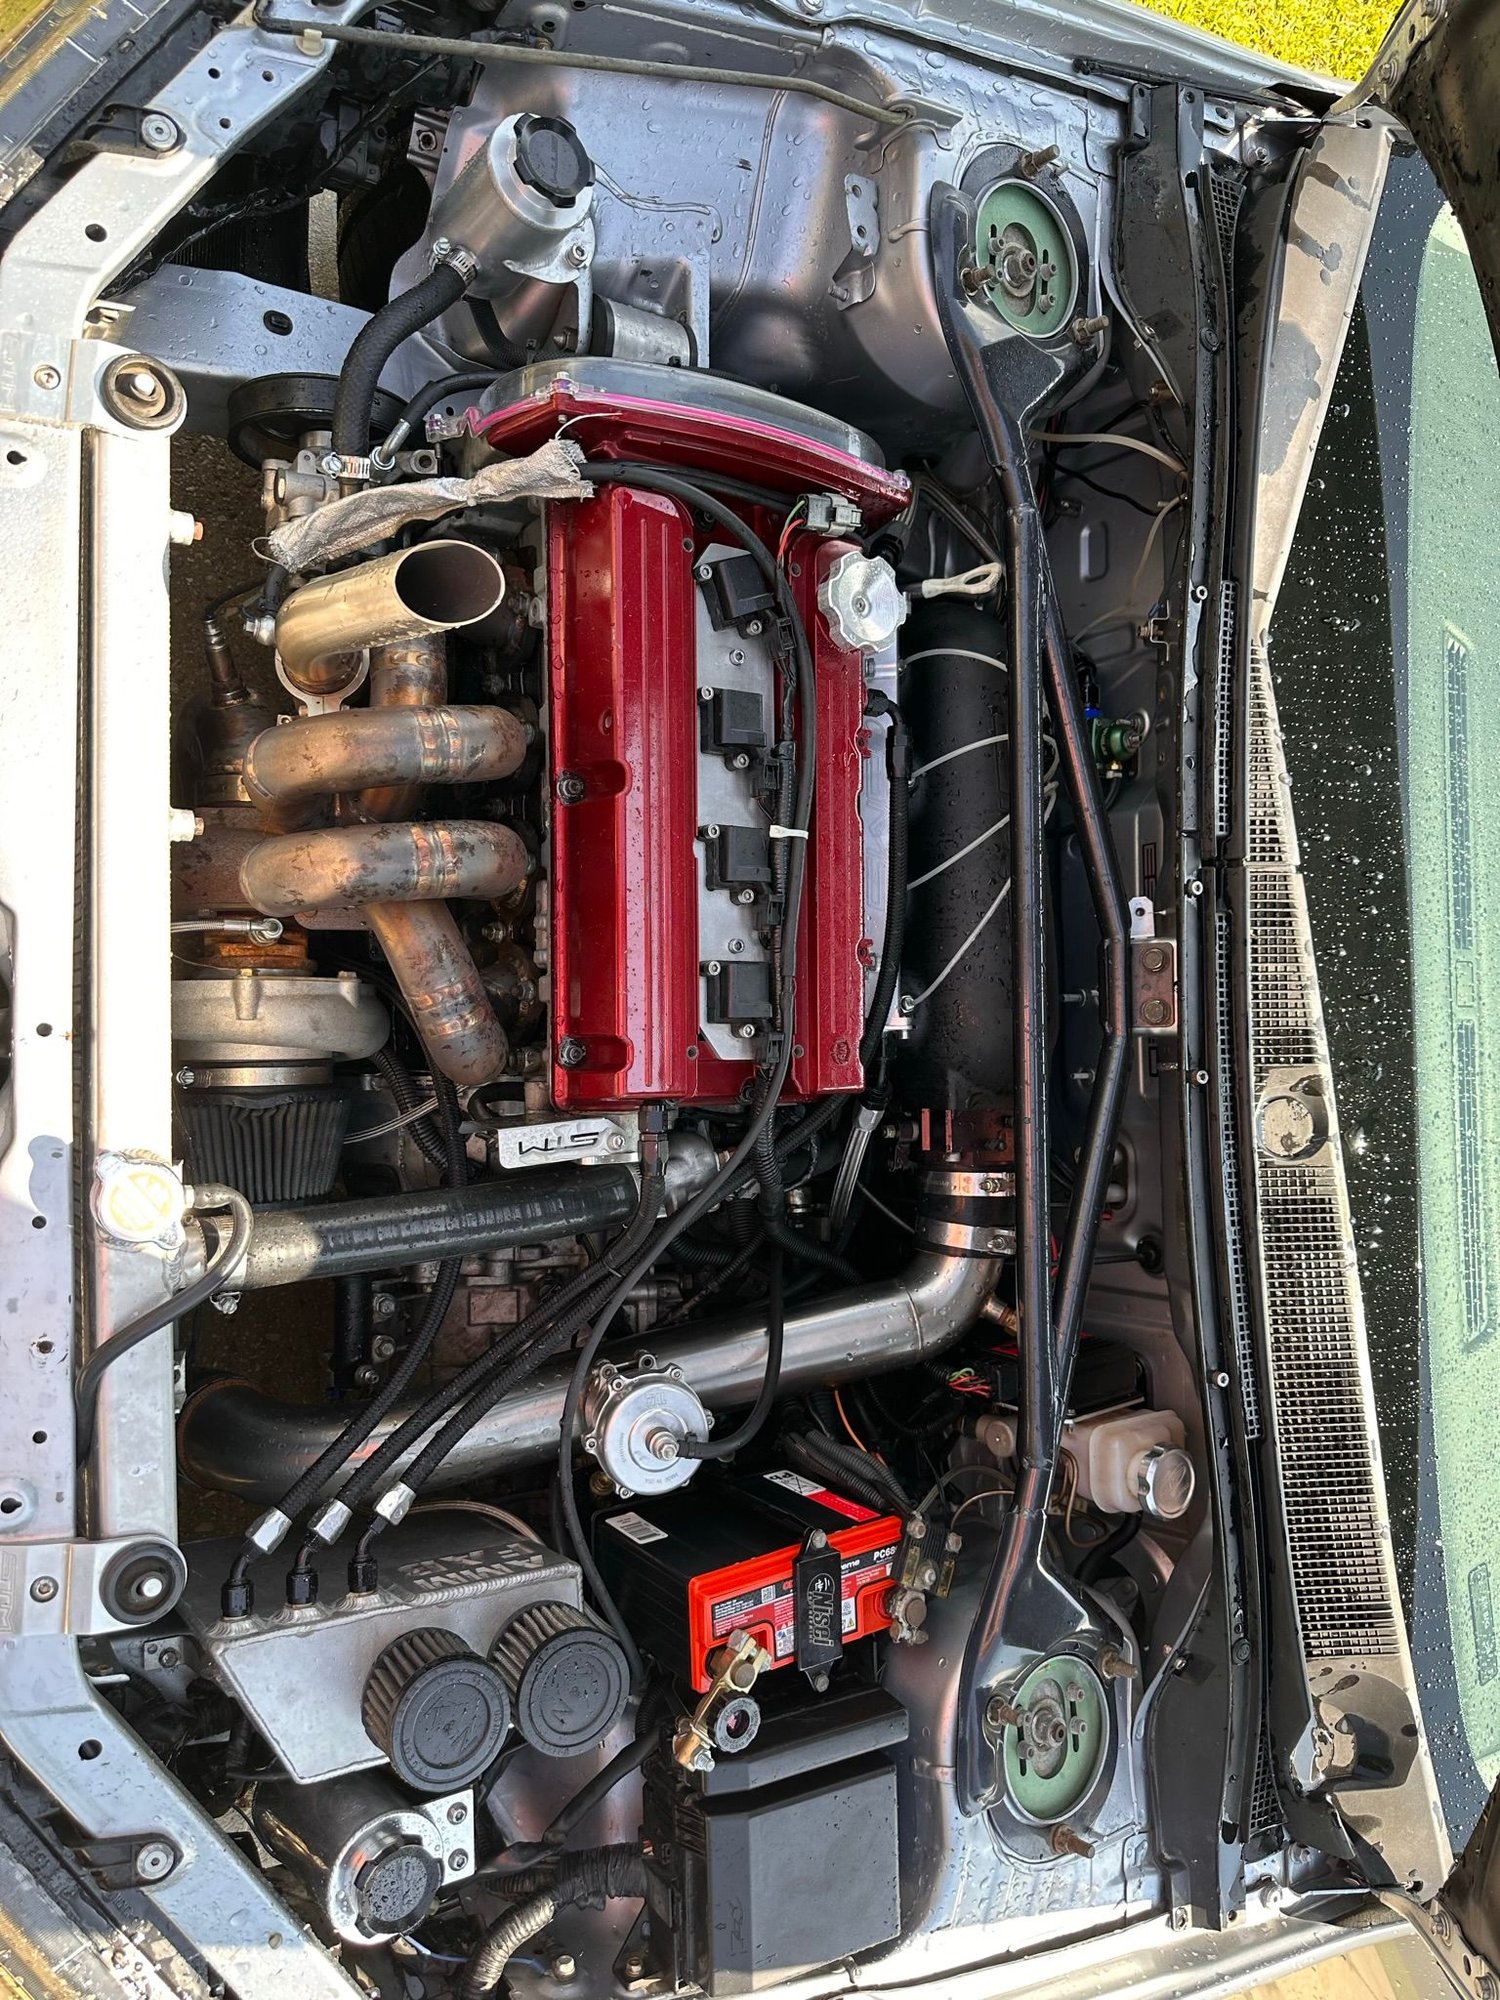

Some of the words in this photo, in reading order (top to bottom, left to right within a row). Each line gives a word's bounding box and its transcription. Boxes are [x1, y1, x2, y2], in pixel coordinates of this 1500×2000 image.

[519, 1132, 599, 1155] STM
[873, 1546, 897, 1561] PC68
[812, 1590, 835, 1647] Nisei
